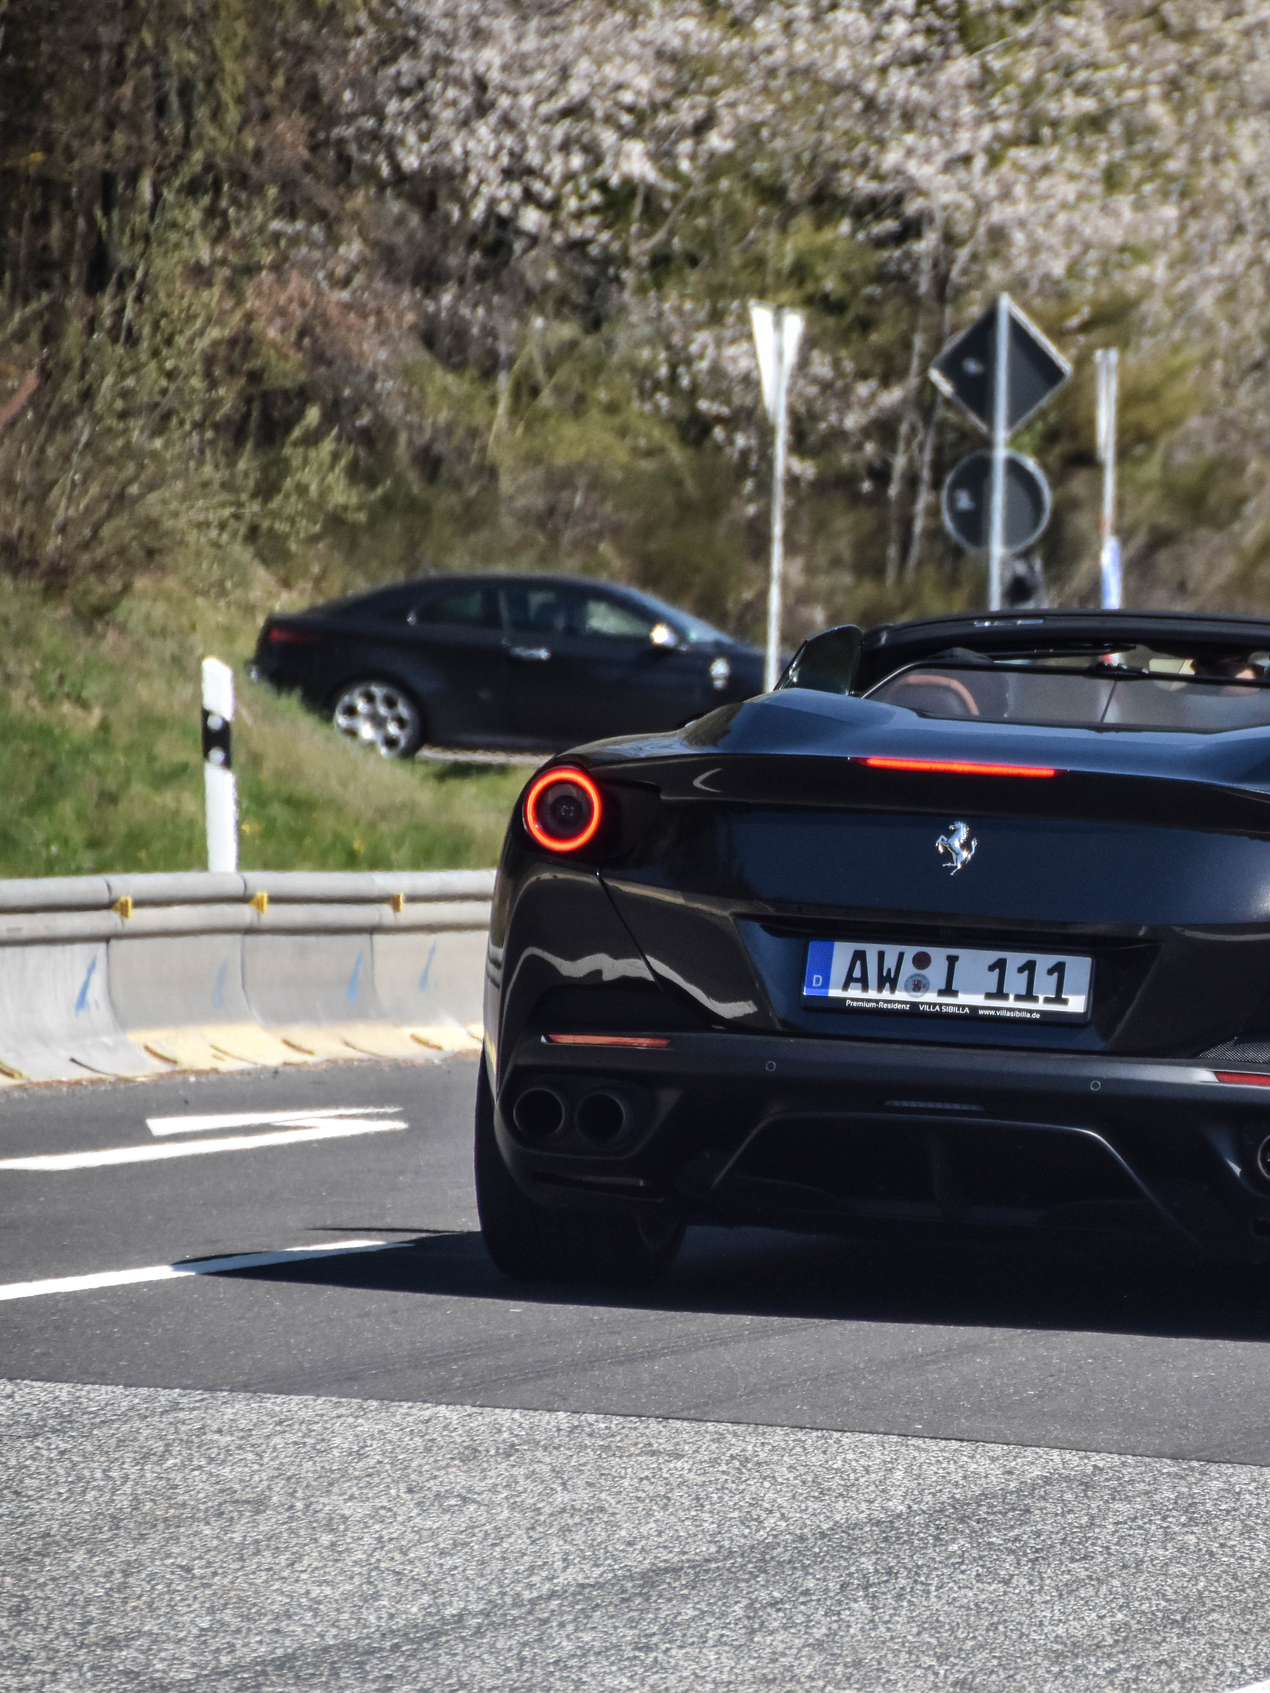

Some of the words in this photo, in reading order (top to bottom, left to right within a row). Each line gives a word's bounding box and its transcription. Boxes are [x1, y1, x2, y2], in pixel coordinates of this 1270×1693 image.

[812, 974, 822, 987] D
[841, 949, 905, 995] AW
[936, 954, 960, 999] I
[984, 957, 1070, 1006] 111
[845, 999, 910, 1011] Premium-Residenz
[919, 1004, 941, 1013] VILLA
[941, 1005, 970, 1014] SIBILLA
[978, 1008, 1041, 1019] www.villasibilla.de
